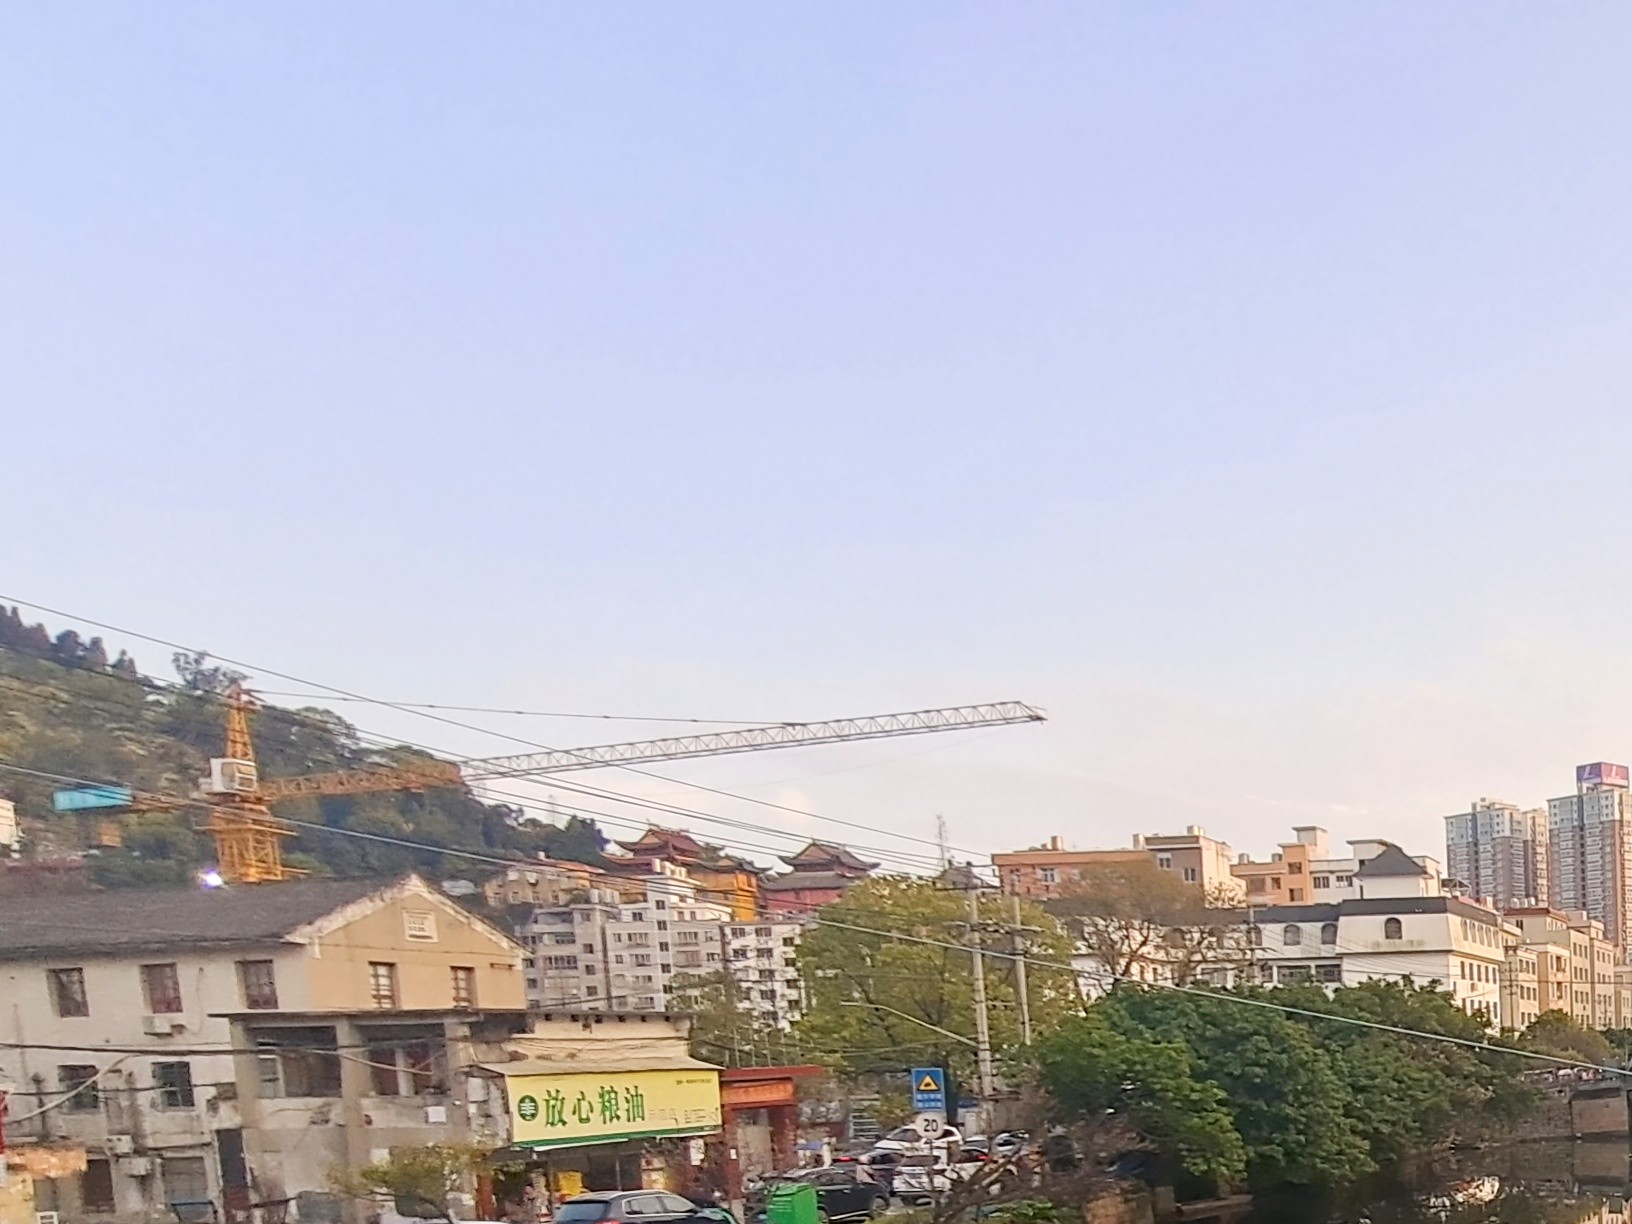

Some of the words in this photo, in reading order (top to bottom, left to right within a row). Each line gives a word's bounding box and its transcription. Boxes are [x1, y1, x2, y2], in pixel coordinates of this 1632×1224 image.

[542, 1085, 646, 1127] 放心粮油
[923, 1118, 939, 1133] 20
